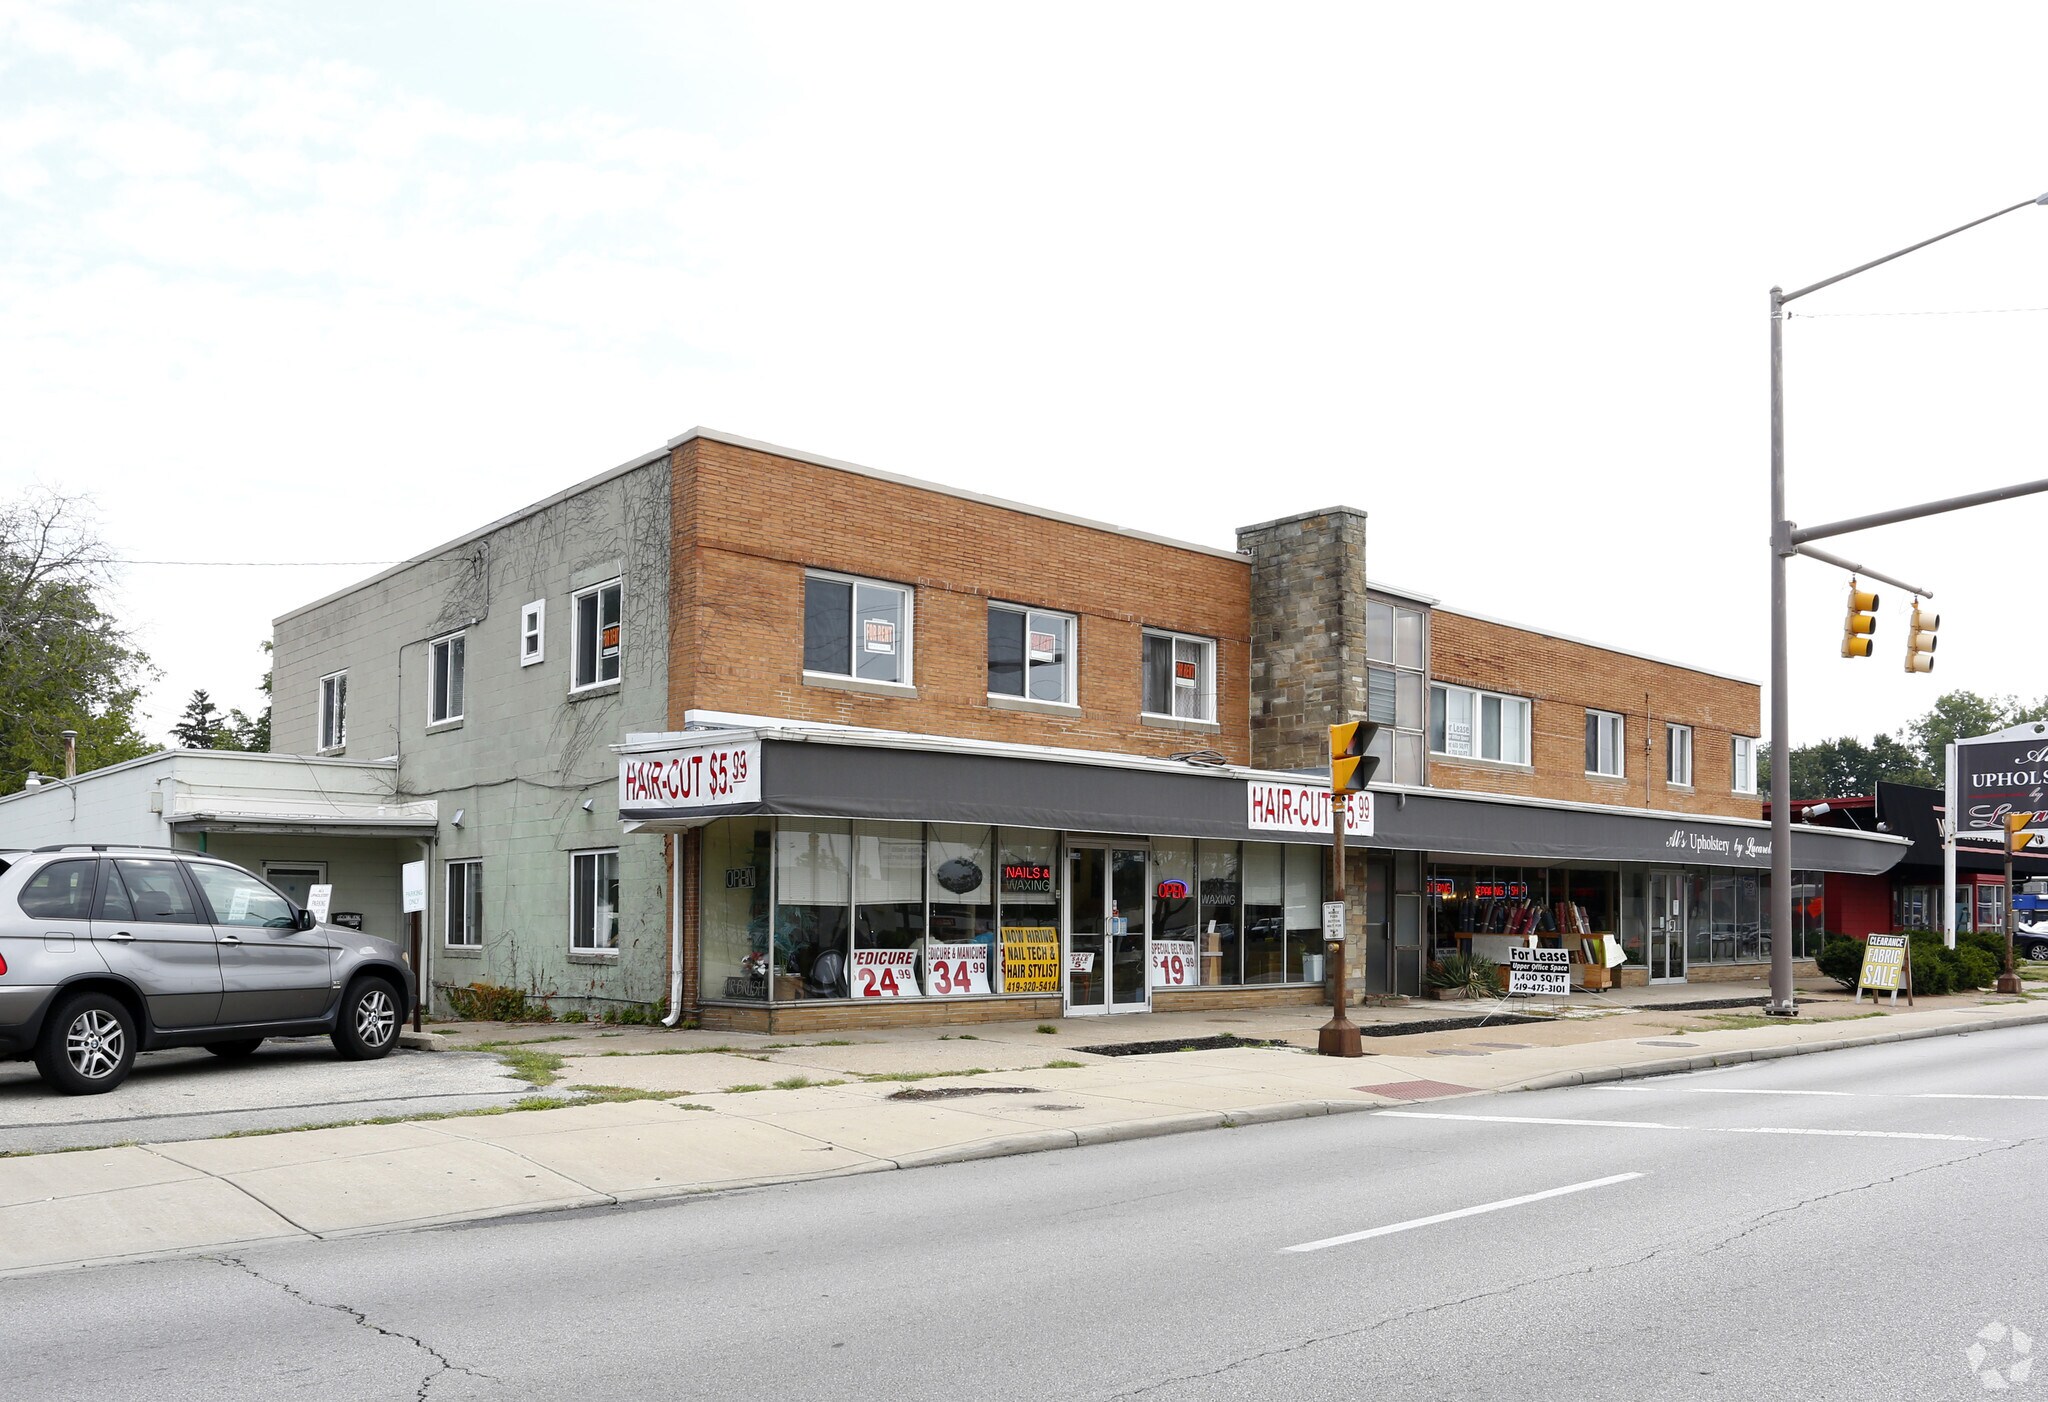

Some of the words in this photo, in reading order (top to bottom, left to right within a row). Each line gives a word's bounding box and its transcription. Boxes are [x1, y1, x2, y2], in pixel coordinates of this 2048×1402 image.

[1453, 724, 1470, 734] Lease
[626, 756, 703, 800] HAIR-CUT
[2029, 787, 2044, 802] by
[1252, 786, 1331, 827] HAIR-CUT
[1345, 793, 1370, 829] 5.99
[1666, 829, 1688, 848] Al's
[1690, 833, 1730, 855] Upholstery
[1733, 838, 1744, 858] by
[726, 868, 755, 889] OPEN
[1006, 866, 1040, 878] NAILS
[1043, 868, 1050, 878] &
[406, 889, 423, 897] PARKING
[1007, 880, 1050, 892] WAXING
[1158, 883, 1187, 899] OPEN
[1511, 885, 1526, 895] SHP
[1201, 894, 1236, 906] WAXING
[1005, 929, 1024, 943] NOW
[1025, 929, 1054, 943] HIRING
[1869, 936, 1905, 947] CLEARANCE
[952, 948, 956, 959] &
[957, 946, 986, 960] MANICURE
[1008, 946, 1026, 961] NAIL
[1027, 946, 1047, 960] TECH
[1050, 946, 1056, 960] &
[1151, 942, 1170, 955] SPECIAL
[1511, 948, 1530, 960] For
[1533, 949, 1567, 962] Lease
[1867, 948, 1901, 964] FABRIC
[1007, 964, 1026, 979] HAIR
[1028, 963, 1057, 978] STYLIST
[1512, 962, 1530, 971] Upper
[1531, 963, 1549, 971] Office
[1550, 964, 1568, 972] Space
[1540, 974, 1566, 983] SQ/FT
[1863, 964, 1898, 986] SALE
[1007, 981, 1057, 993] 419-320-5414
[1514, 983, 1565, 993] 419-475-3101
